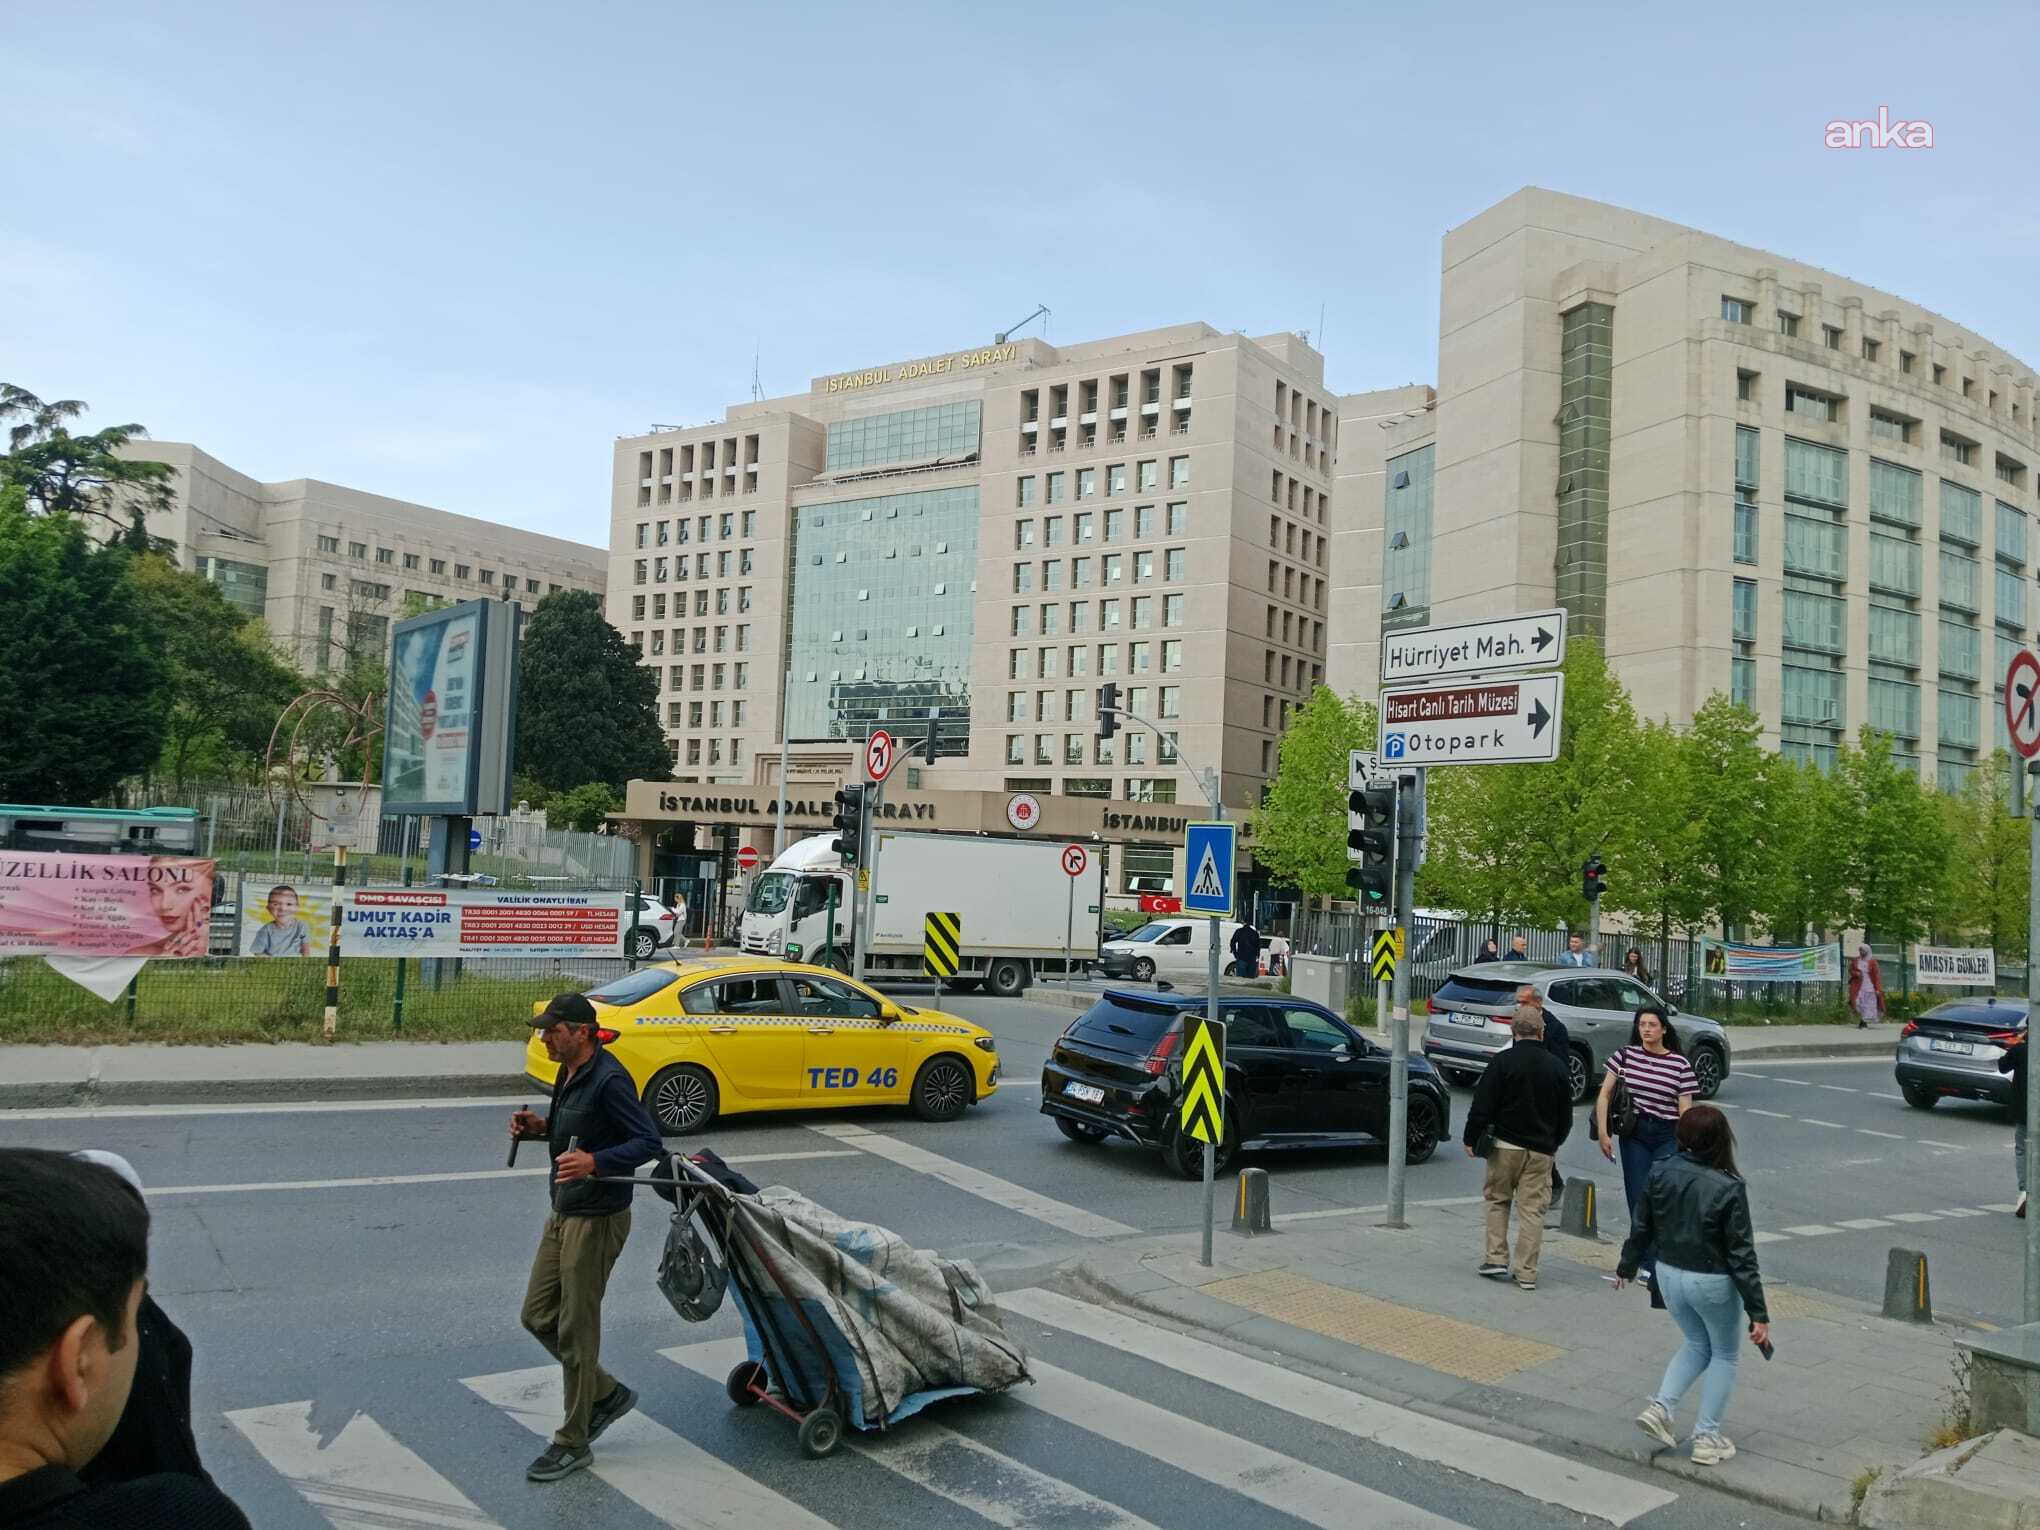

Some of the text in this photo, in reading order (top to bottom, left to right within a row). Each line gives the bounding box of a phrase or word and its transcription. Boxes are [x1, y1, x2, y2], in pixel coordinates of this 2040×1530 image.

[899, 357, 953, 381] ADALET
[961, 344, 1017, 370] SARAYI
[1391, 633, 1524, 670] Hürriyet Mah.
[1387, 691, 1518, 720] Hisart Canlı Tarih Müzesi
[1409, 729, 1504, 756] Otopark
[660, 791, 759, 815] İSTANBUL
[0, 860, 193, 883] ZELLİK SALONU
[497, 896, 531, 904] VALİLİK
[347, 909, 452, 924] UMUT KADİR
[1919, 954, 1955, 974] AMASYA
[807, 1067, 898, 1089] TED 46
